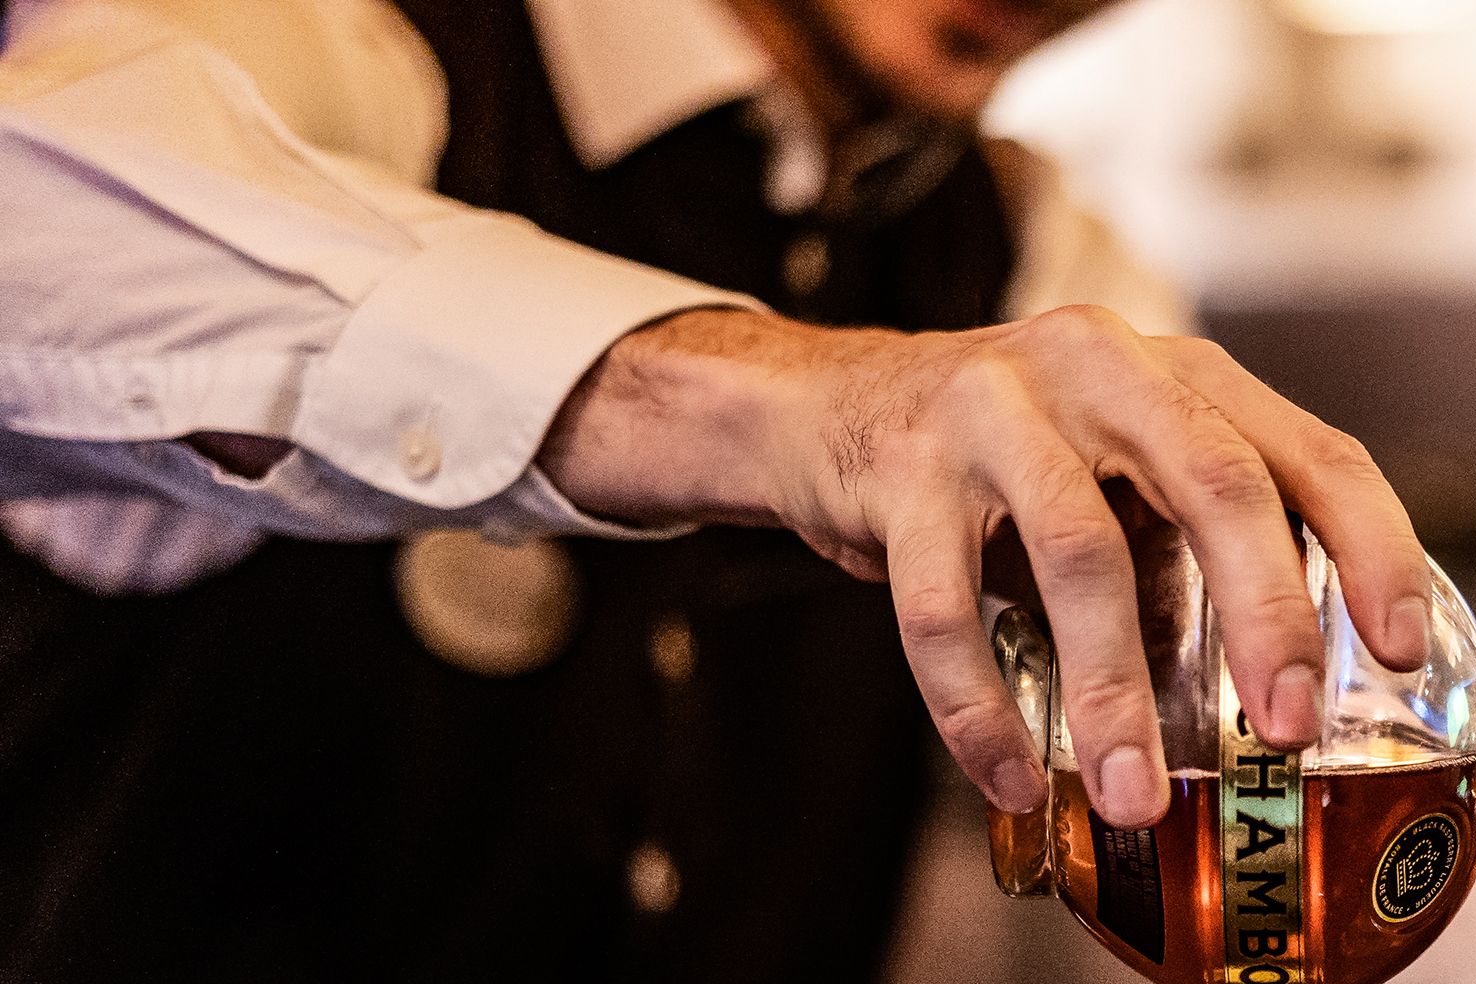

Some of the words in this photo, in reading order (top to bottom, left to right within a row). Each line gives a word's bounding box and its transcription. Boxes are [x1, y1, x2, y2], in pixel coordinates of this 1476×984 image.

[1413, 821, 1438, 835] BLACK
[1439, 823, 1455, 870] RASPBERRY
[1380, 844, 1401, 881] ROYALE
[1379, 883, 1386, 896] DE
[1415, 872, 1447, 908] LIQUEUR
[1380, 895, 1404, 915] FRANCE
